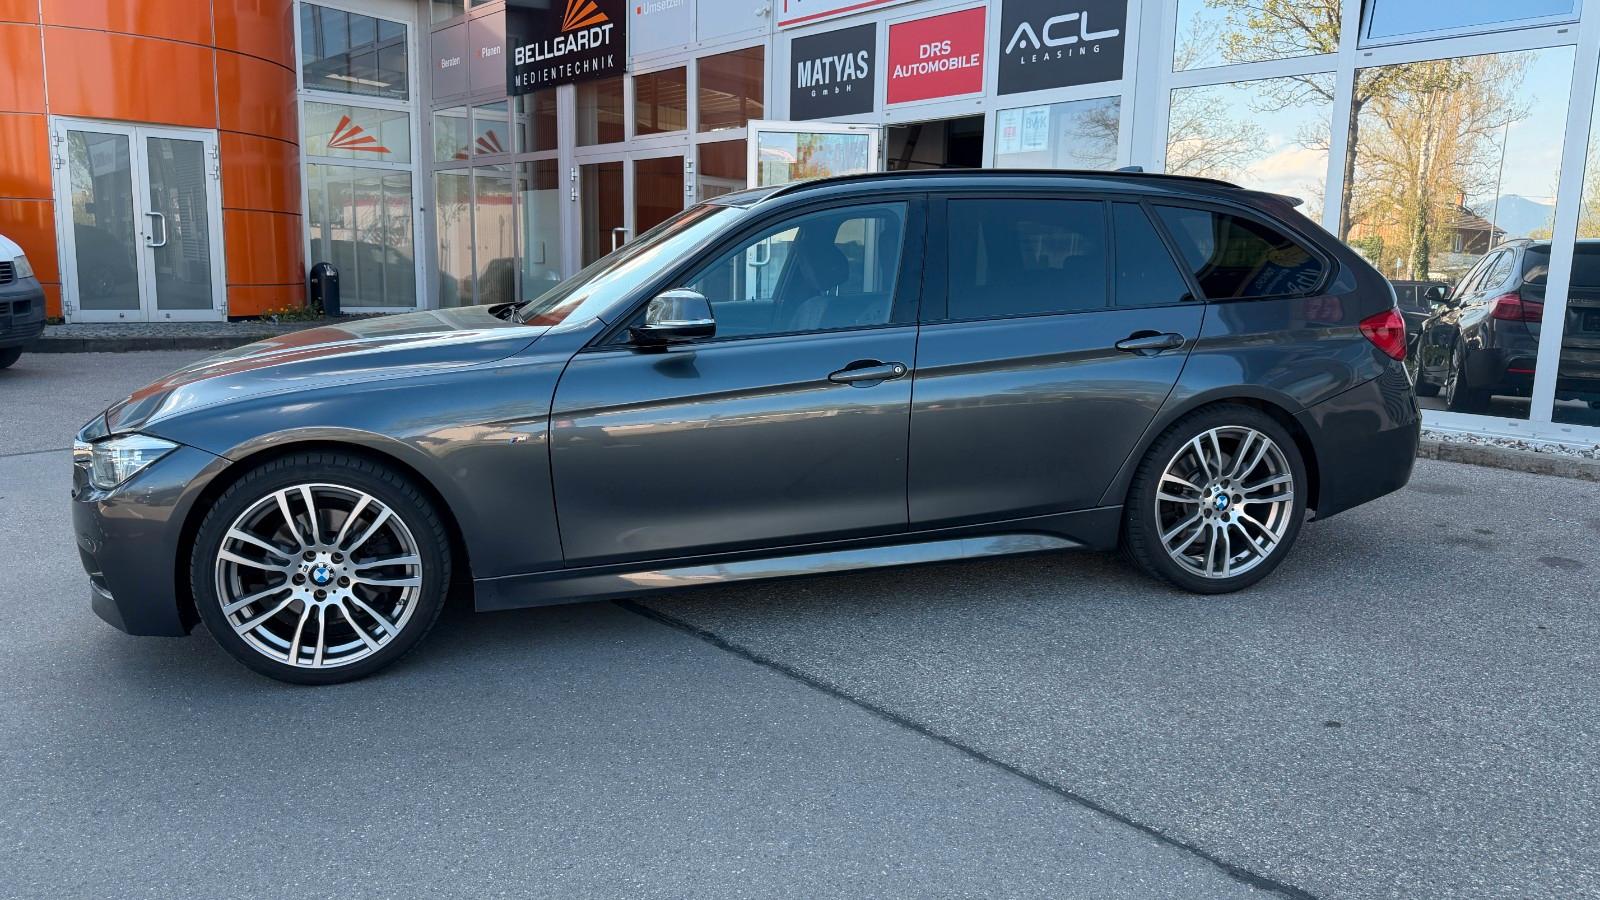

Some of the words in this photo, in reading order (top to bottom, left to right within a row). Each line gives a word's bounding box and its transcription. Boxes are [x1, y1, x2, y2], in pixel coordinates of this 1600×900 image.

[643, 0, 684, 15] Umsetzen
[1005, 10, 1119, 55] ACL
[481, 45, 501, 58] Planen
[514, 23, 614, 66] BELLGARDT
[919, 40, 951, 60] DRS
[1020, 45, 1101, 64] LEASING
[441, 56, 461, 69] Beraten
[515, 54, 614, 87] MEDIENTECHNIK
[797, 50, 868, 88] MATYAS
[893, 53, 980, 79] AUTOMOBILE
